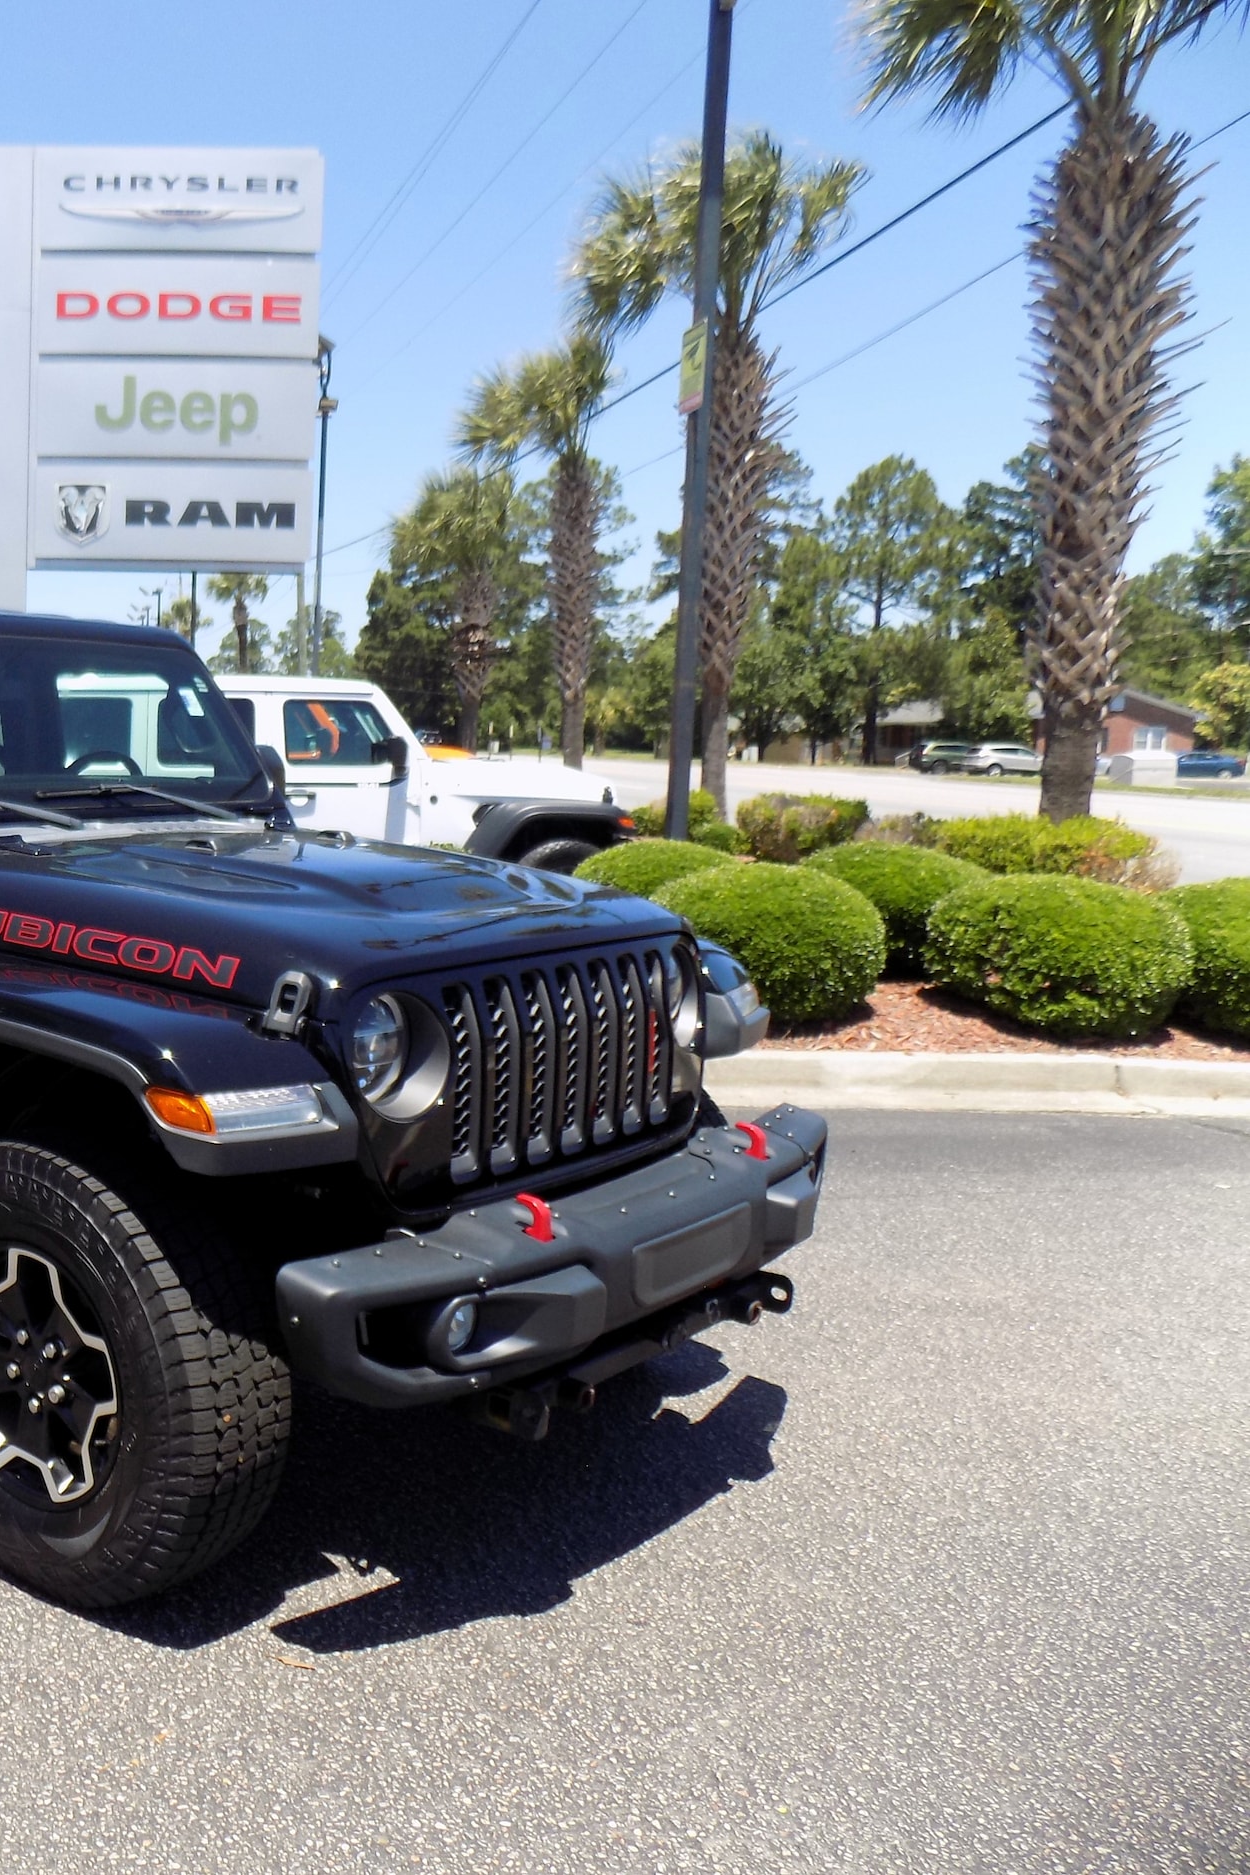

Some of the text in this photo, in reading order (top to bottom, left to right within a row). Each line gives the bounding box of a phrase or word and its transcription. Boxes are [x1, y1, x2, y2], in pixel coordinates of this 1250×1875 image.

[63, 175, 299, 194] CHRYSLER
[56, 291, 302, 323] DODGE
[95, 375, 258, 445] Jeep
[125, 499, 296, 530] RAM
